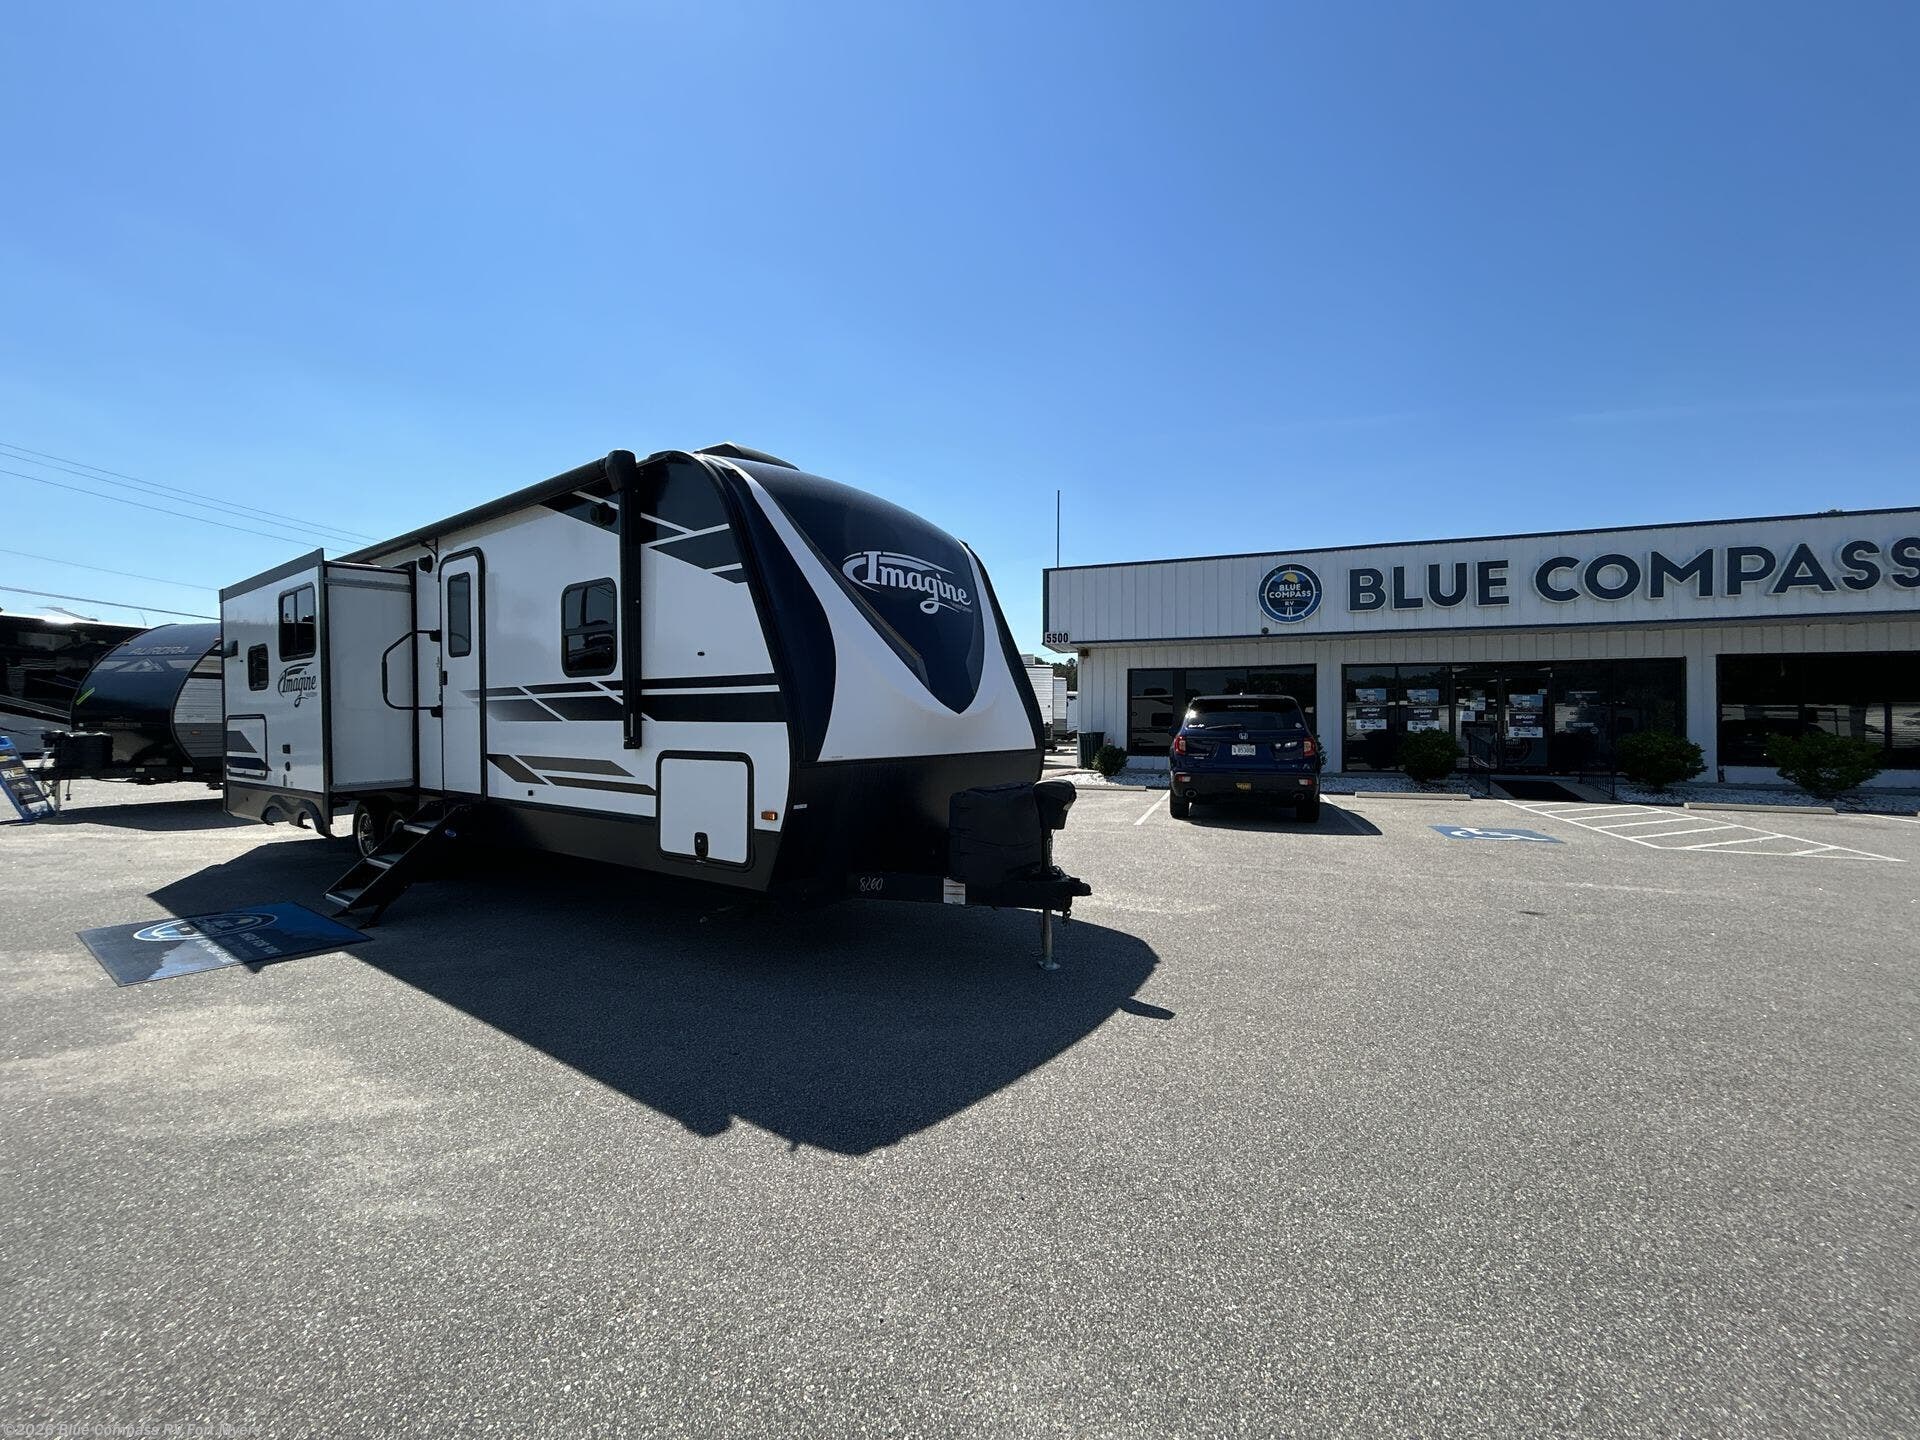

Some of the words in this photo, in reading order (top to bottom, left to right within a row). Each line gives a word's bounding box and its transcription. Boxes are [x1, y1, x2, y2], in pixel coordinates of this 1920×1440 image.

[847, 550, 972, 614] Imagine
[1269, 591, 1312, 599] COMPASS
[1349, 559, 1510, 612] BLUE
[1535, 537, 1920, 603] COMPASS
[1046, 632, 1069, 643] 5500
[279, 667, 317, 708] Imagine
